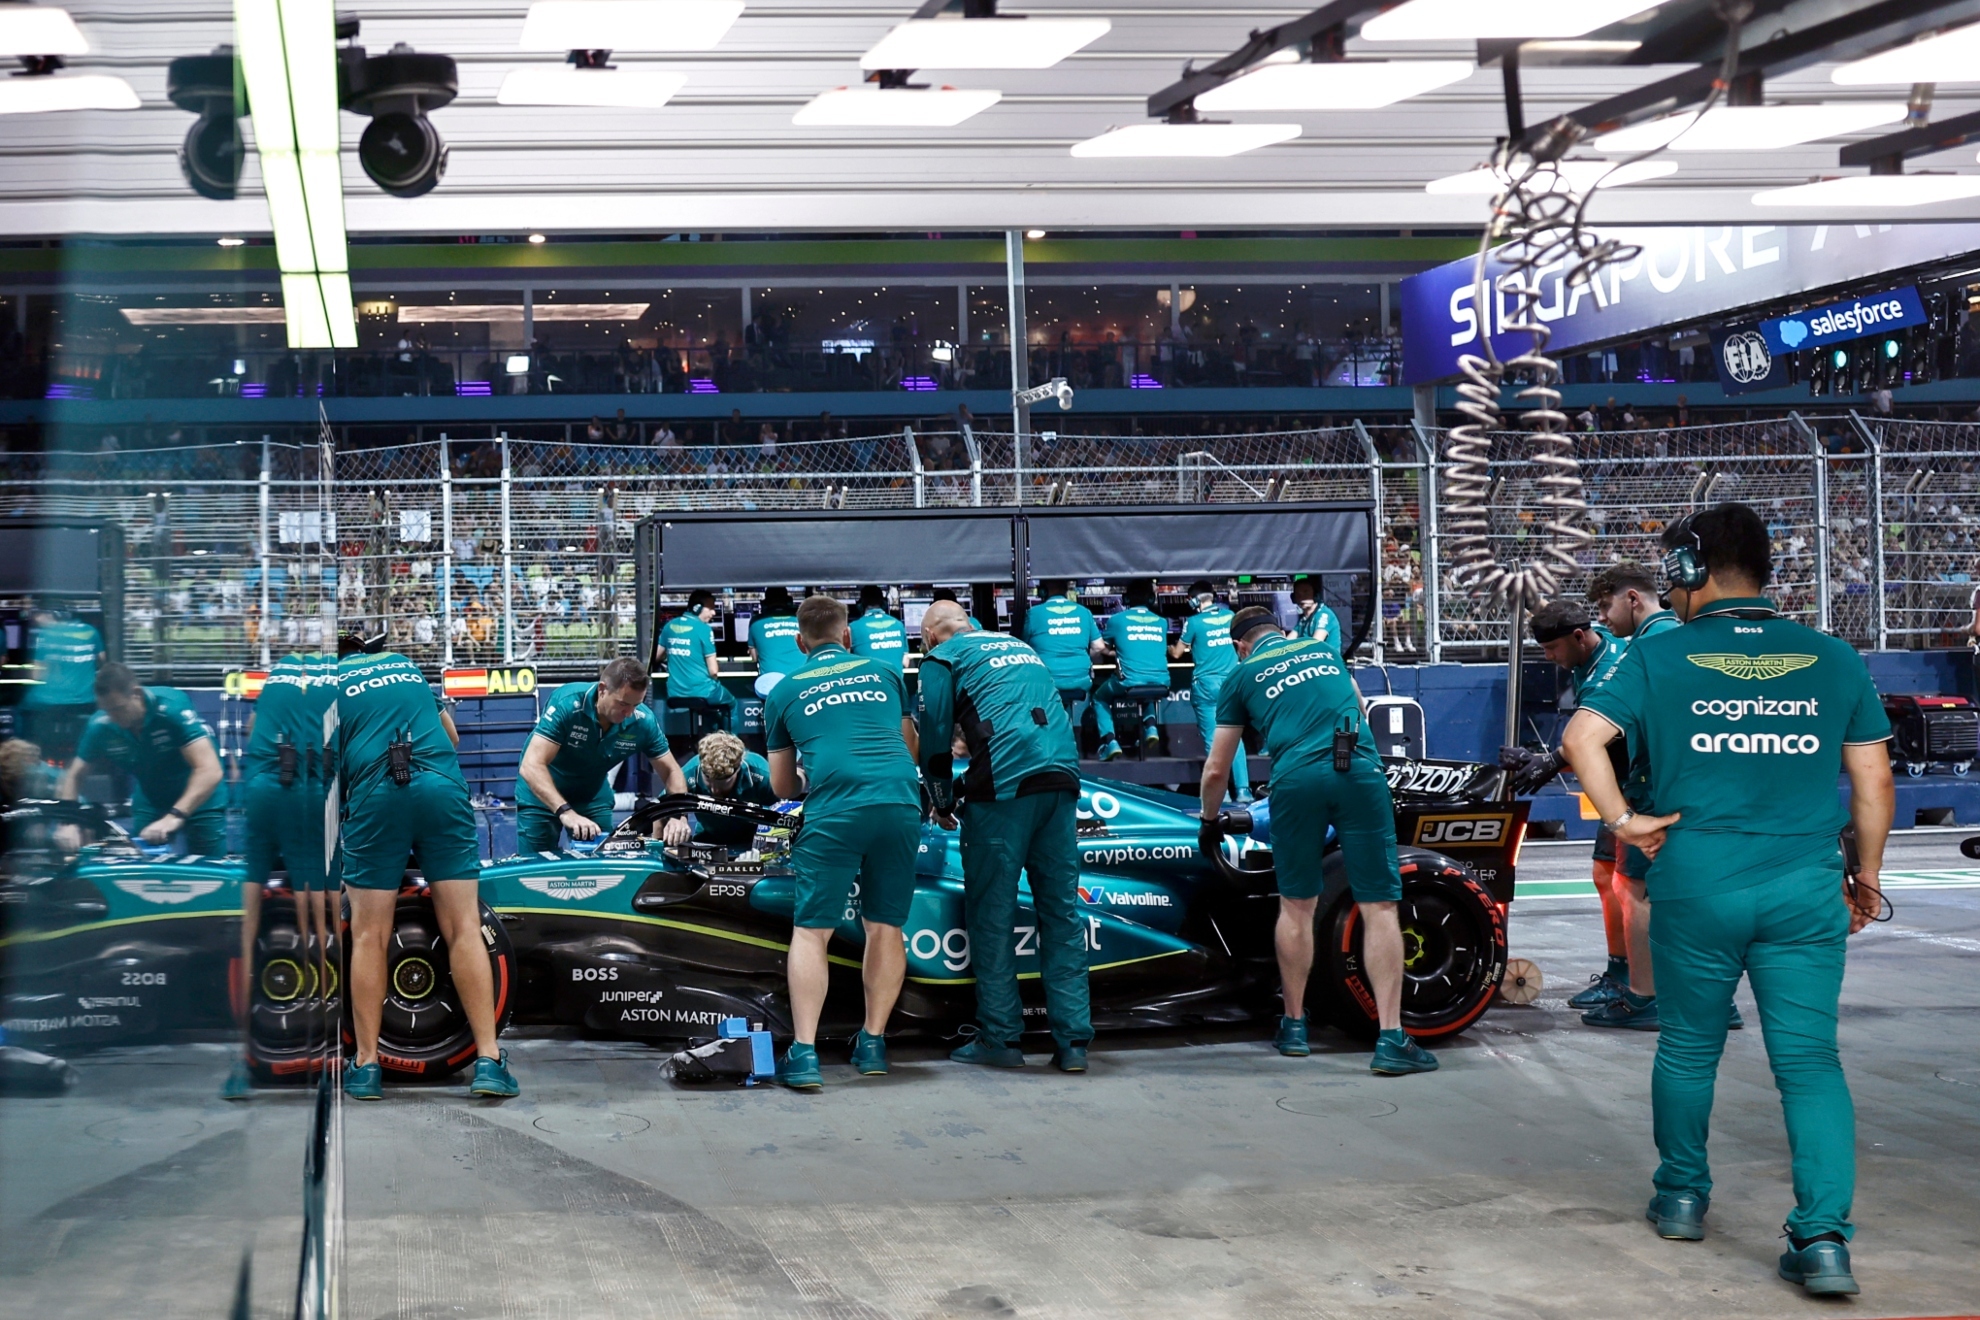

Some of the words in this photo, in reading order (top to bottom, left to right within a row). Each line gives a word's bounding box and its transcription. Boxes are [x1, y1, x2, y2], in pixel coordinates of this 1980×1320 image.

[1810, 299, 1904, 334] salesforce
[763, 622, 799, 631] cognizan
[1048, 617, 1081, 627] cognizant
[1126, 624, 1163, 634] cognizant
[869, 630, 902, 640] cognizant
[1048, 627, 1082, 636] aramco
[1733, 626, 1764, 634] BOSS
[870, 640, 903, 650] aramco
[1127, 633, 1163, 643] aramco
[1207, 638, 1232, 647] aram
[1254, 651, 1335, 683] cognizant
[1725, 659, 1752, 667] ASTON
[1752, 659, 1783, 667] MARTIN
[338, 660, 417, 683] cognizant
[345, 673, 423, 698] aramco
[487, 668, 535, 694] ALO
[798, 673, 882, 700] cognizant
[1265, 664, 1341, 699] aramco
[803, 690, 888, 716] aramco
[1690, 695, 1819, 721] cognizant
[1690, 732, 1820, 755] aramco
[1421, 820, 1502, 843] JCB
[604, 841, 642, 851] aramco
[1083, 844, 1193, 865] crypto.com
[549, 881, 570, 889] ASTON
[571, 880, 596, 888] MARTIN
[709, 884, 746, 897] EPOS
[572, 966, 619, 981] BOSS
[620, 1008, 671, 1022] ASTON
